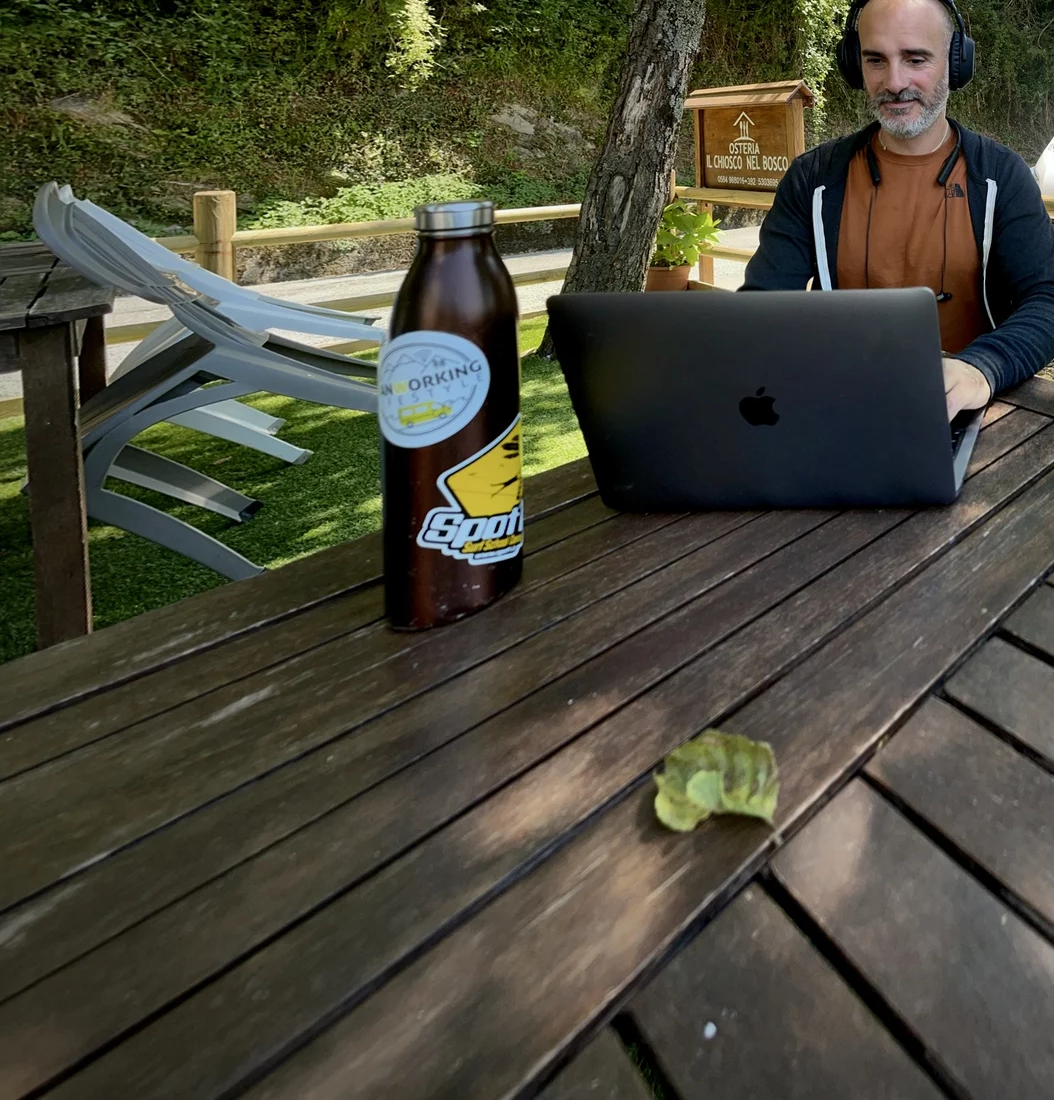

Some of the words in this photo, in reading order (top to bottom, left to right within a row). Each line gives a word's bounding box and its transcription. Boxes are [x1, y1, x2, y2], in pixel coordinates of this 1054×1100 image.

[729, 142, 760, 154] OSTERIA
[706, 154, 713, 168] IL
[713, 155, 743, 170] CHIOSCO
[746, 155, 760, 170] NEL
[762, 155, 789, 171] BOSCO
[381, 360, 482, 396] ANWORKING
